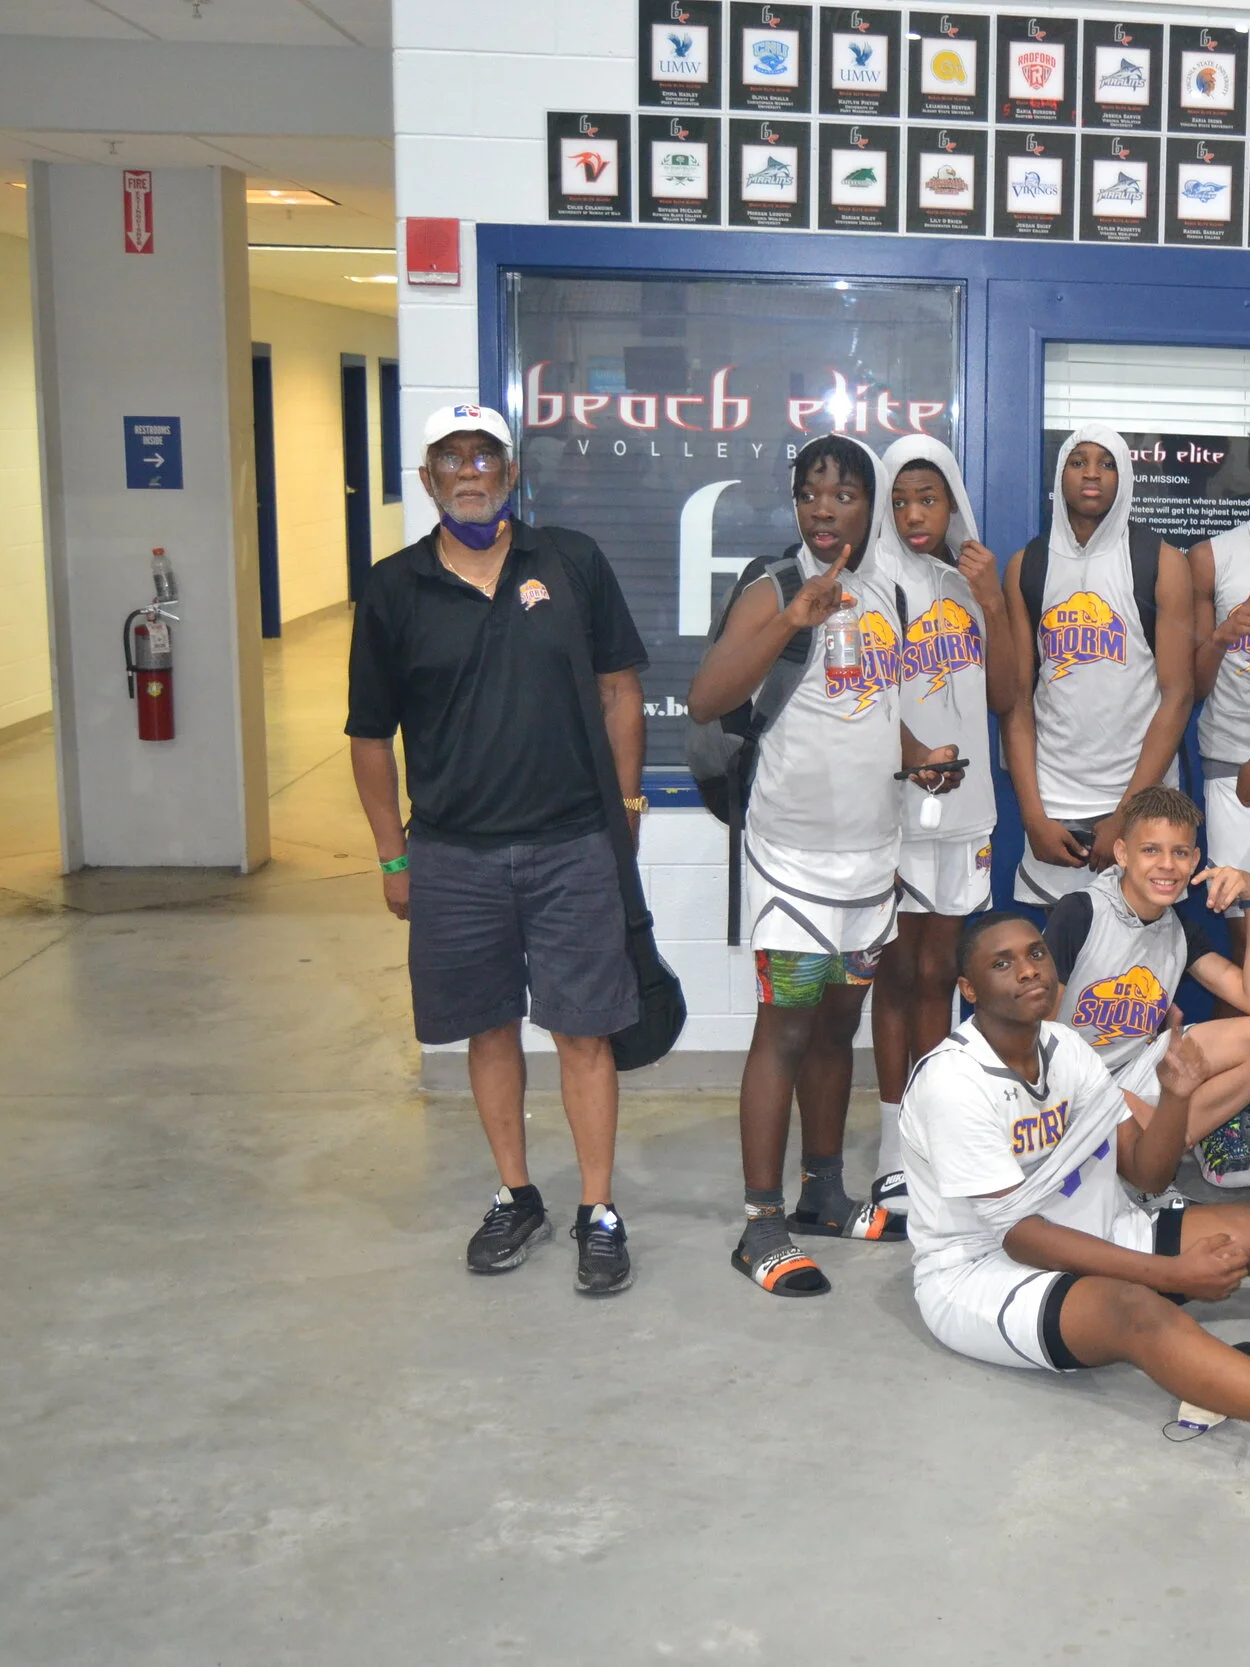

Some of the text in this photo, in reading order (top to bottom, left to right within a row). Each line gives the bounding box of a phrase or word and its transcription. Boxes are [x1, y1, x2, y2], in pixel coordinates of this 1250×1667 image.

[752, 40, 790, 58] CNU
[659, 60, 701, 74] UMW
[1018, 52, 1057, 68] RADFORD
[840, 68, 881, 84] UMW
[128, 178, 147, 189] FIRE
[1011, 185, 1058, 199] VIKINGS
[526, 360, 946, 434] beach elite
[134, 424, 171, 435] RESTROOMS
[143, 435, 164, 446] INSIDE
[577, 438, 797, 459] VOLLEYB
[1129, 441, 1225, 464] ach elite
[1134, 475, 1191, 484] UR MISSION:
[1142, 496, 1190, 505] environment
[1193, 497, 1216, 506] where
[1219, 498, 1250, 507] talented
[1156, 506, 1170, 514] will
[1171, 508, 1185, 516] get
[1186, 507, 1200, 515] the
[1201, 507, 1230, 517] highest
[1231, 508, 1250, 516] level
[1149, 515, 1188, 526] necessary
[1190, 517, 1199, 525] to
[1200, 518, 1232, 526] advance
[1169, 527, 1205, 537] volleyball
[1057, 610, 1079, 623] DC
[1041, 623, 1127, 666] STORM
[902, 631, 984, 682] STORM
[1114, 982, 1131, 996] DC
[1072, 998, 1168, 1035] STORM
